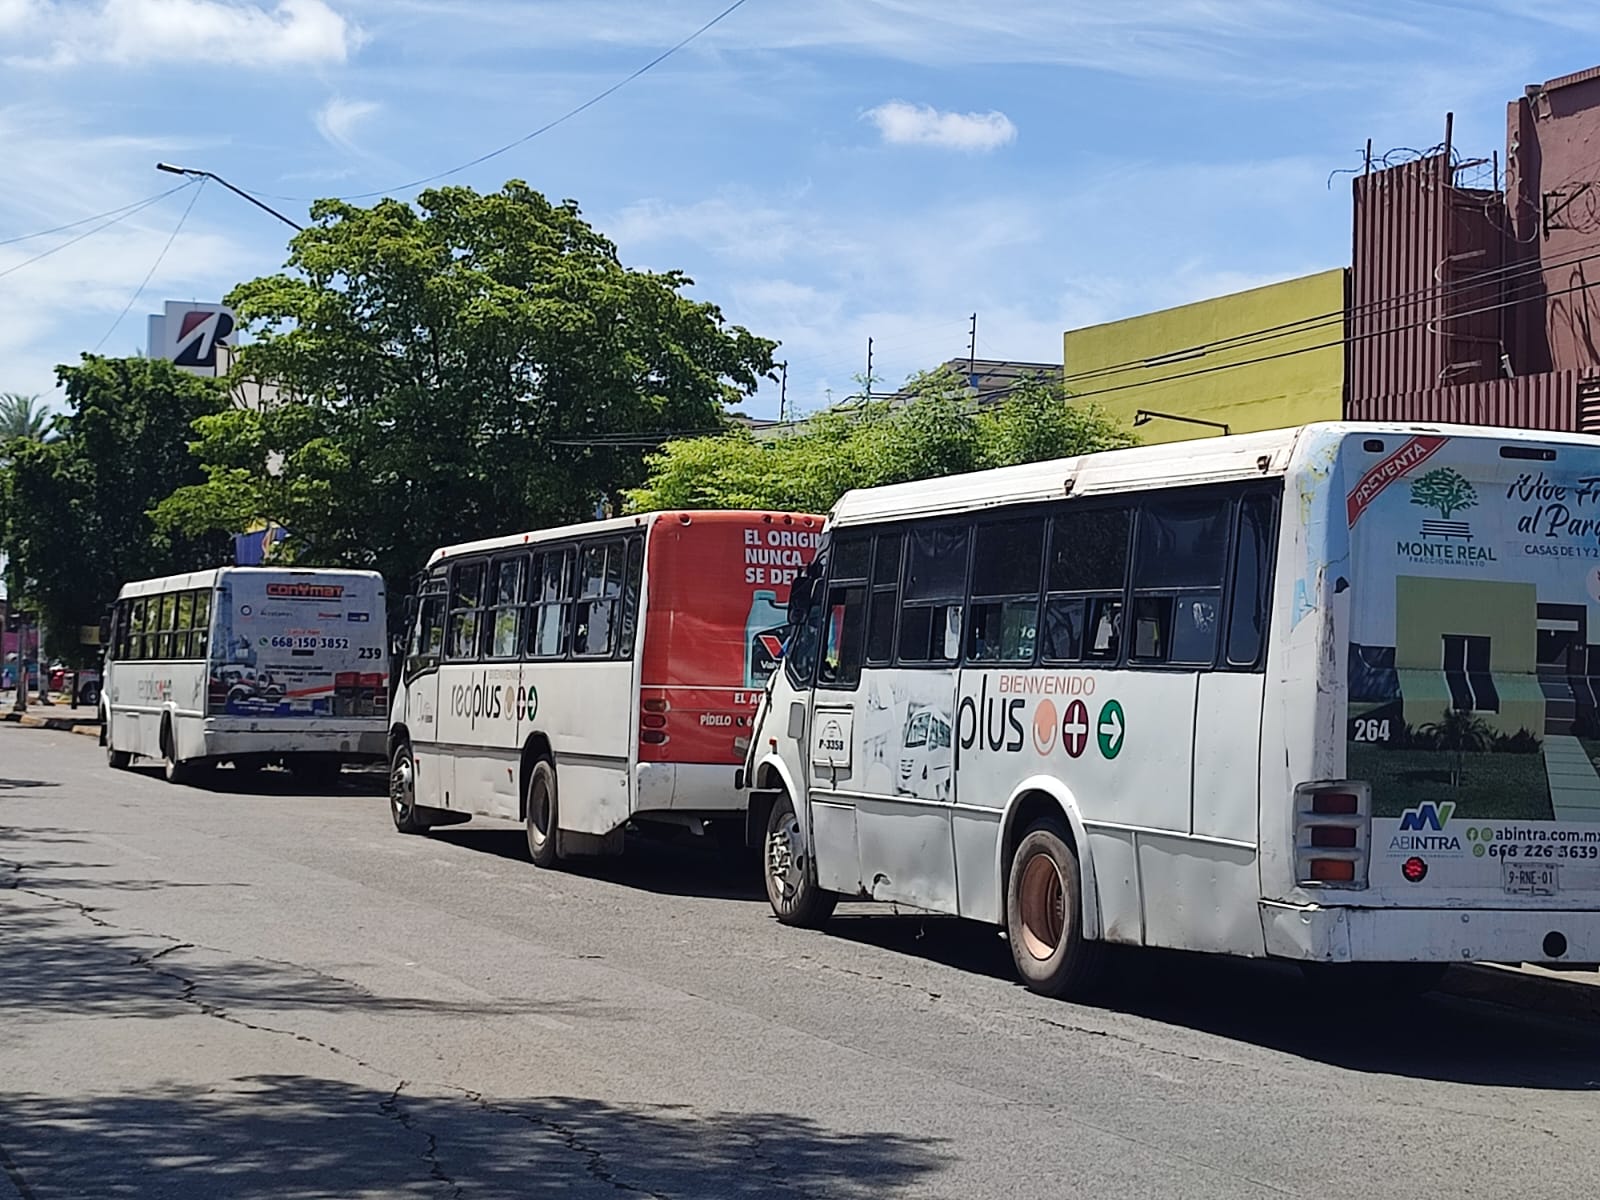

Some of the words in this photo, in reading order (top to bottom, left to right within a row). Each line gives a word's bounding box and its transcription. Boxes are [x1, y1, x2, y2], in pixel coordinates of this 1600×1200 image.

[1355, 442, 1427, 506] PREVENTA
[1518, 505, 1543, 534] al
[744, 529, 762, 546] EL
[745, 548, 803, 567] NUNCA
[1397, 541, 1457, 560] MONTE
[1458, 545, 1497, 562] REAL
[1525, 544, 1559, 556] CASAS
[1561, 546, 1575, 557] DE
[1576, 547, 1581, 557] 1
[1583, 547, 1590, 557] Y
[1592, 548, 1599, 558] 2
[1409, 556, 1485, 568] FRACCIONAMIENTO
[745, 567, 765, 585] SE
[358, 647, 382, 660] 239
[999, 675, 1096, 697] BIENVENIDO
[734, 693, 746, 704] EL
[700, 711, 732, 727] PÍDELO
[1354, 719, 1391, 742] 264
[1389, 836, 1461, 850] ABINTRA
[1488, 844, 1517, 858] 668
[1524, 844, 1553, 858] 226
[1558, 845, 1598, 860] 3639
